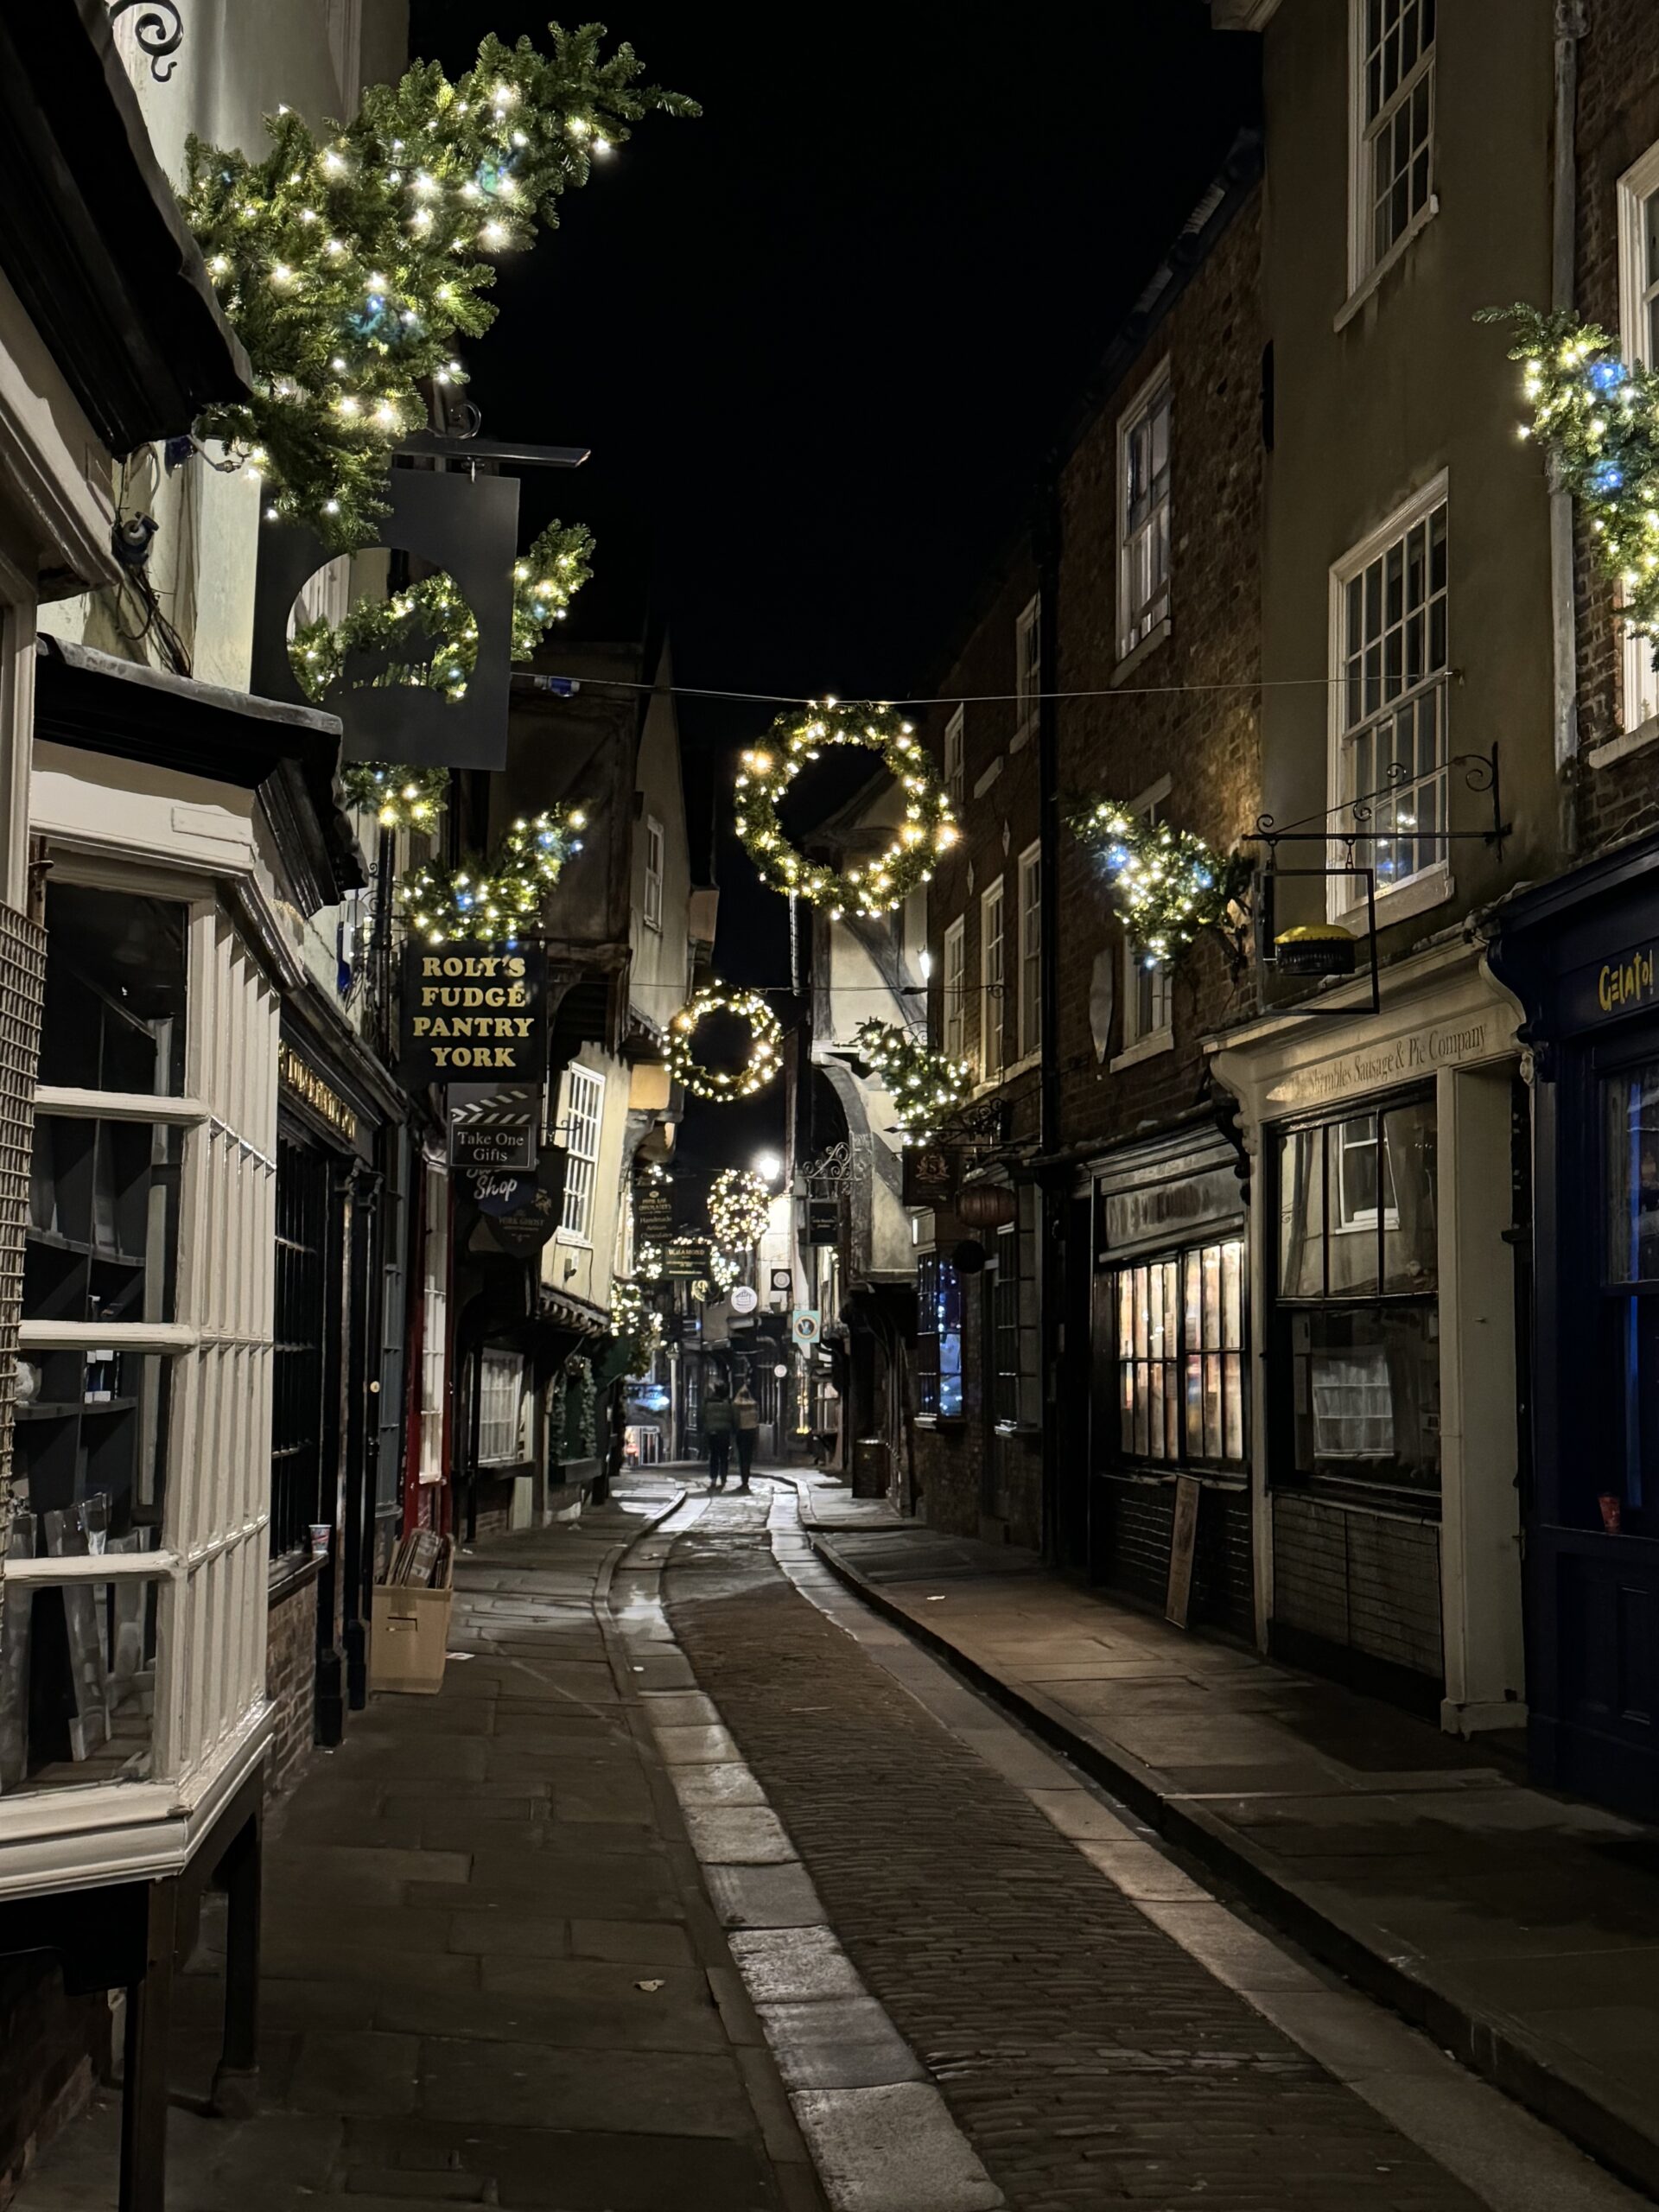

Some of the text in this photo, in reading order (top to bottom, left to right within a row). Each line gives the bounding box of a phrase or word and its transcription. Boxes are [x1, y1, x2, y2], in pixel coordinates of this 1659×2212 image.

[422, 957, 526, 977] ROLY'S
[421, 987, 526, 1007] FUDGE
[412, 1016, 535, 1037] PANTRY
[430, 1046, 517, 1067] YORK
[1311, 1062, 1351, 1094] Shambles
[1355, 1054, 1394, 1081] Sausage
[1395, 1039, 1404, 1070] &
[1408, 1037, 1424, 1066] Pie
[1429, 1022, 1488, 1061] Company
[457, 1131, 524, 1147] Take One
[473, 1147, 508, 1161] Gifts
[474, 1174, 518, 1202] Shop
